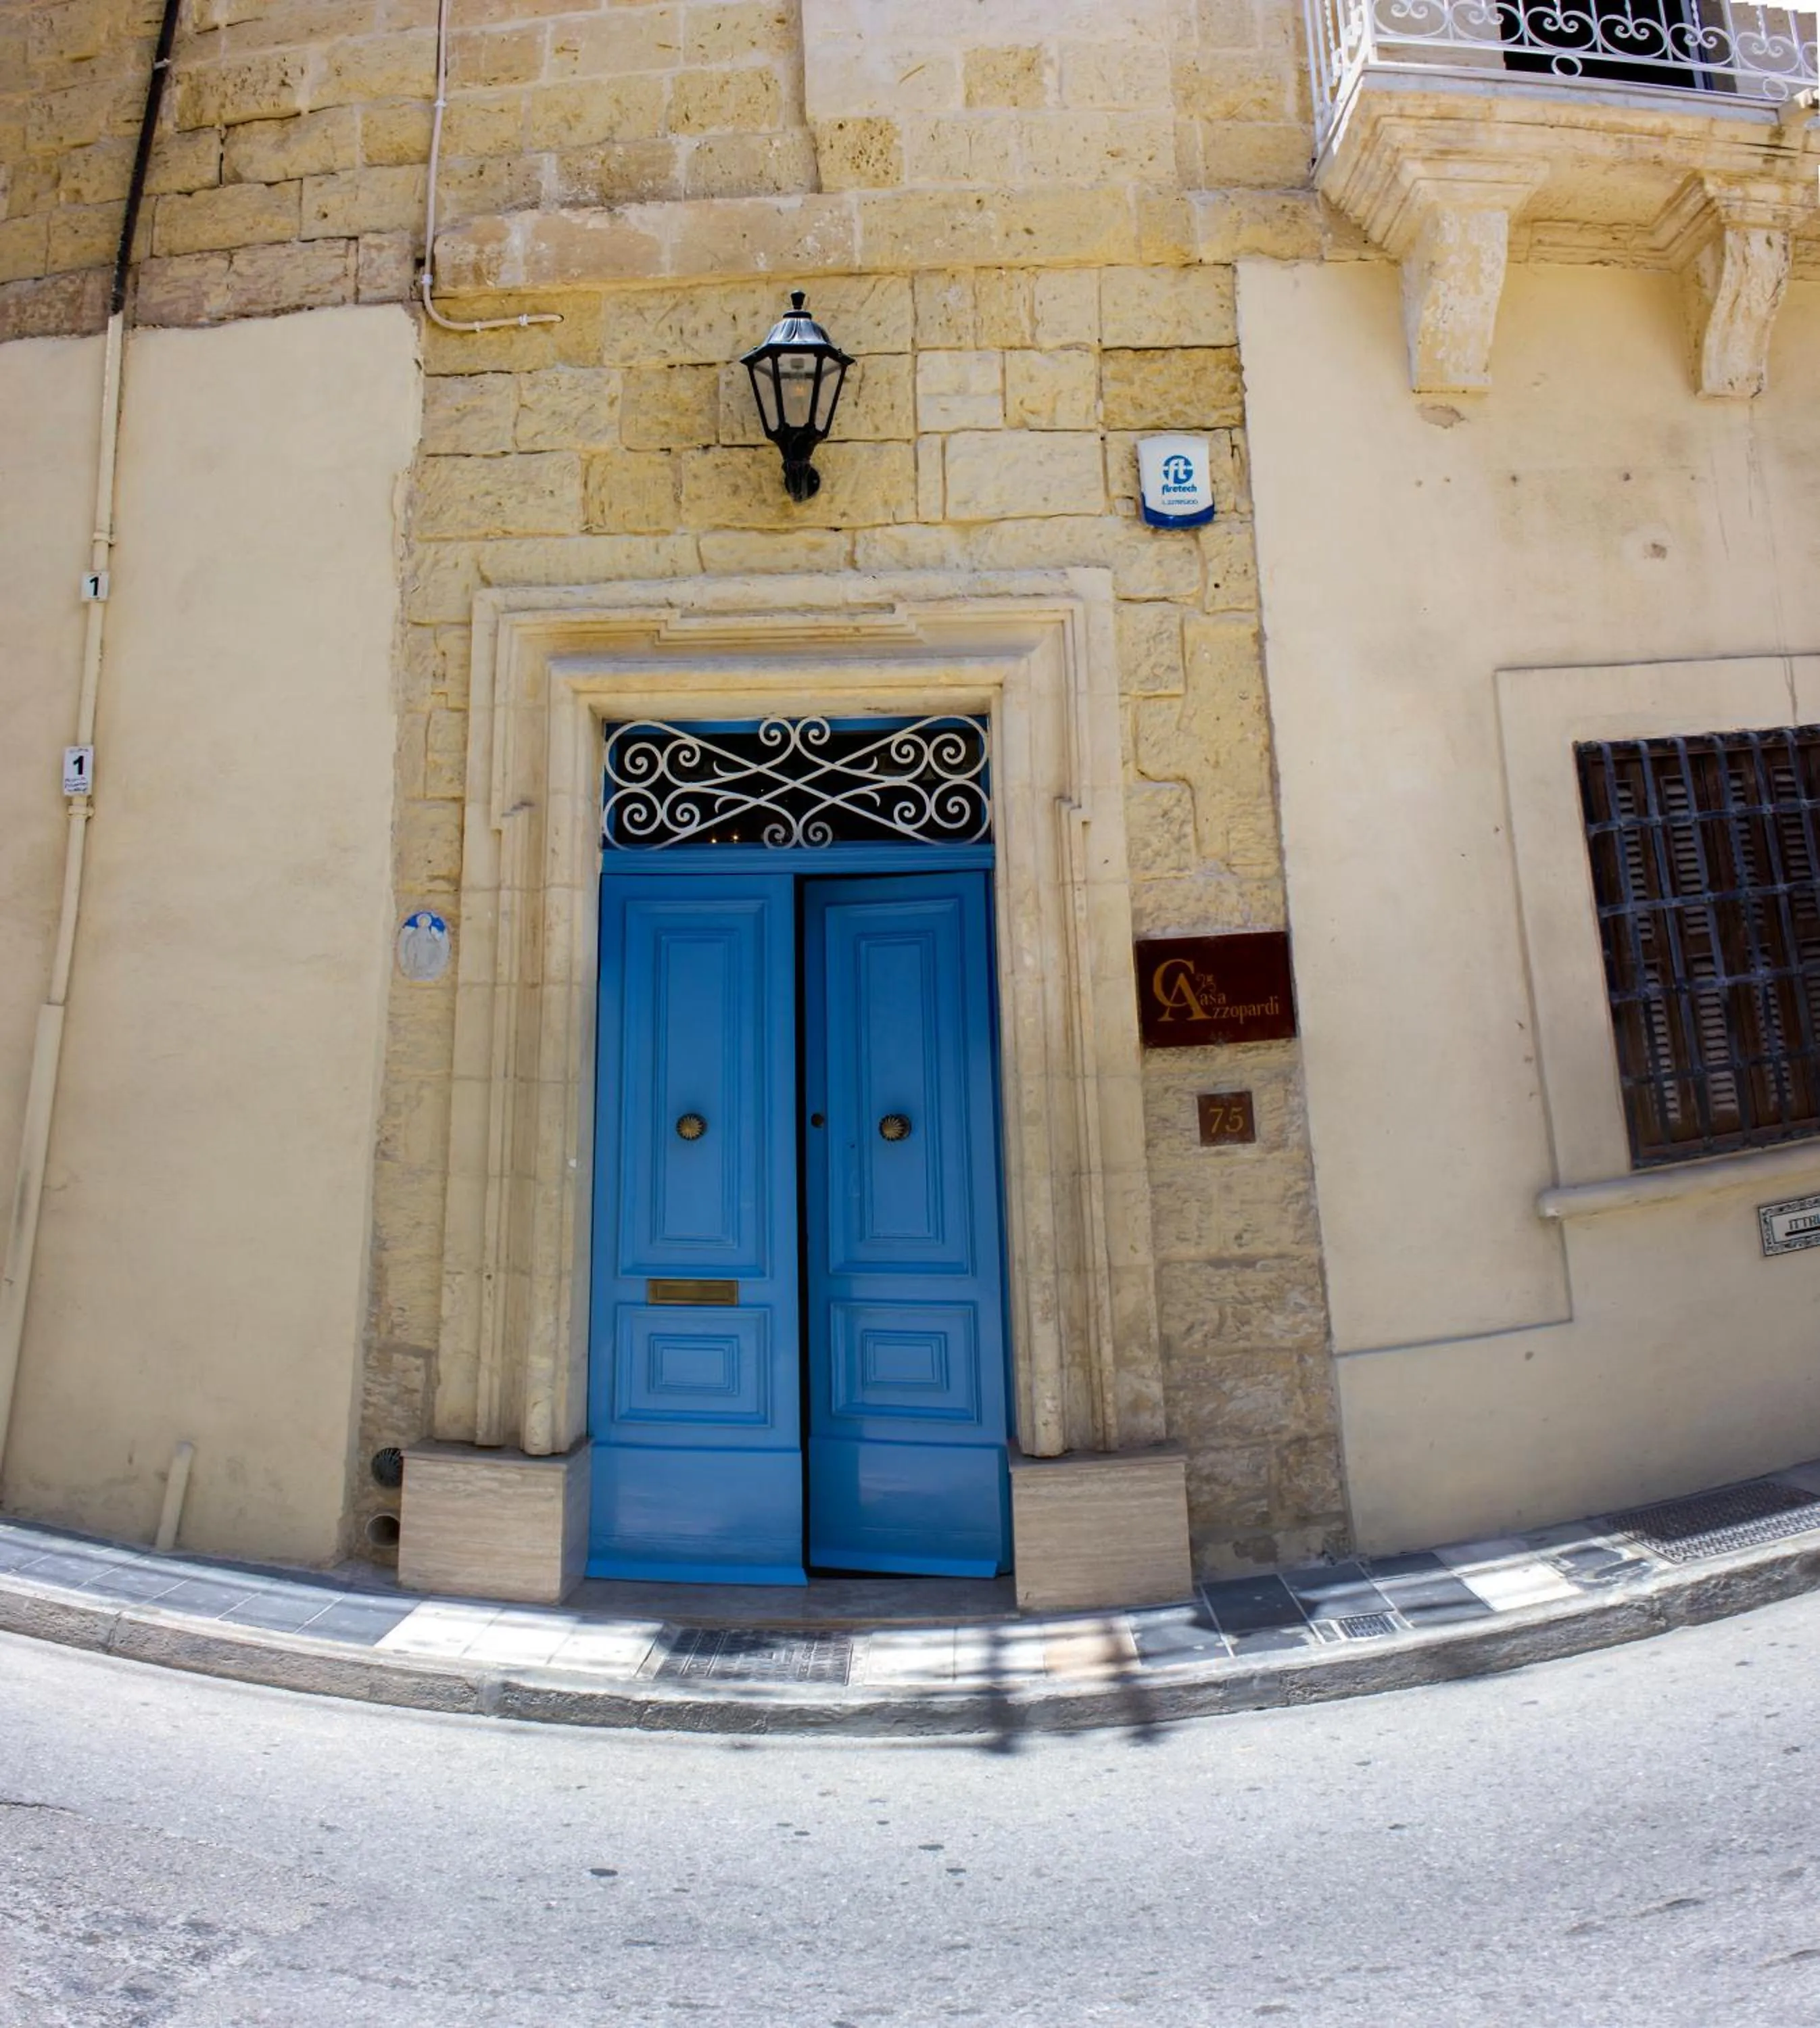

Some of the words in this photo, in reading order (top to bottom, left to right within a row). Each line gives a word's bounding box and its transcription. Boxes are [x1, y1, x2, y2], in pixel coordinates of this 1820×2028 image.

[1162, 484, 1197, 495] firetech
[89, 576, 99, 596] 1
[73, 755, 84, 775] 1
[1209, 1107, 1244, 1134] 75
